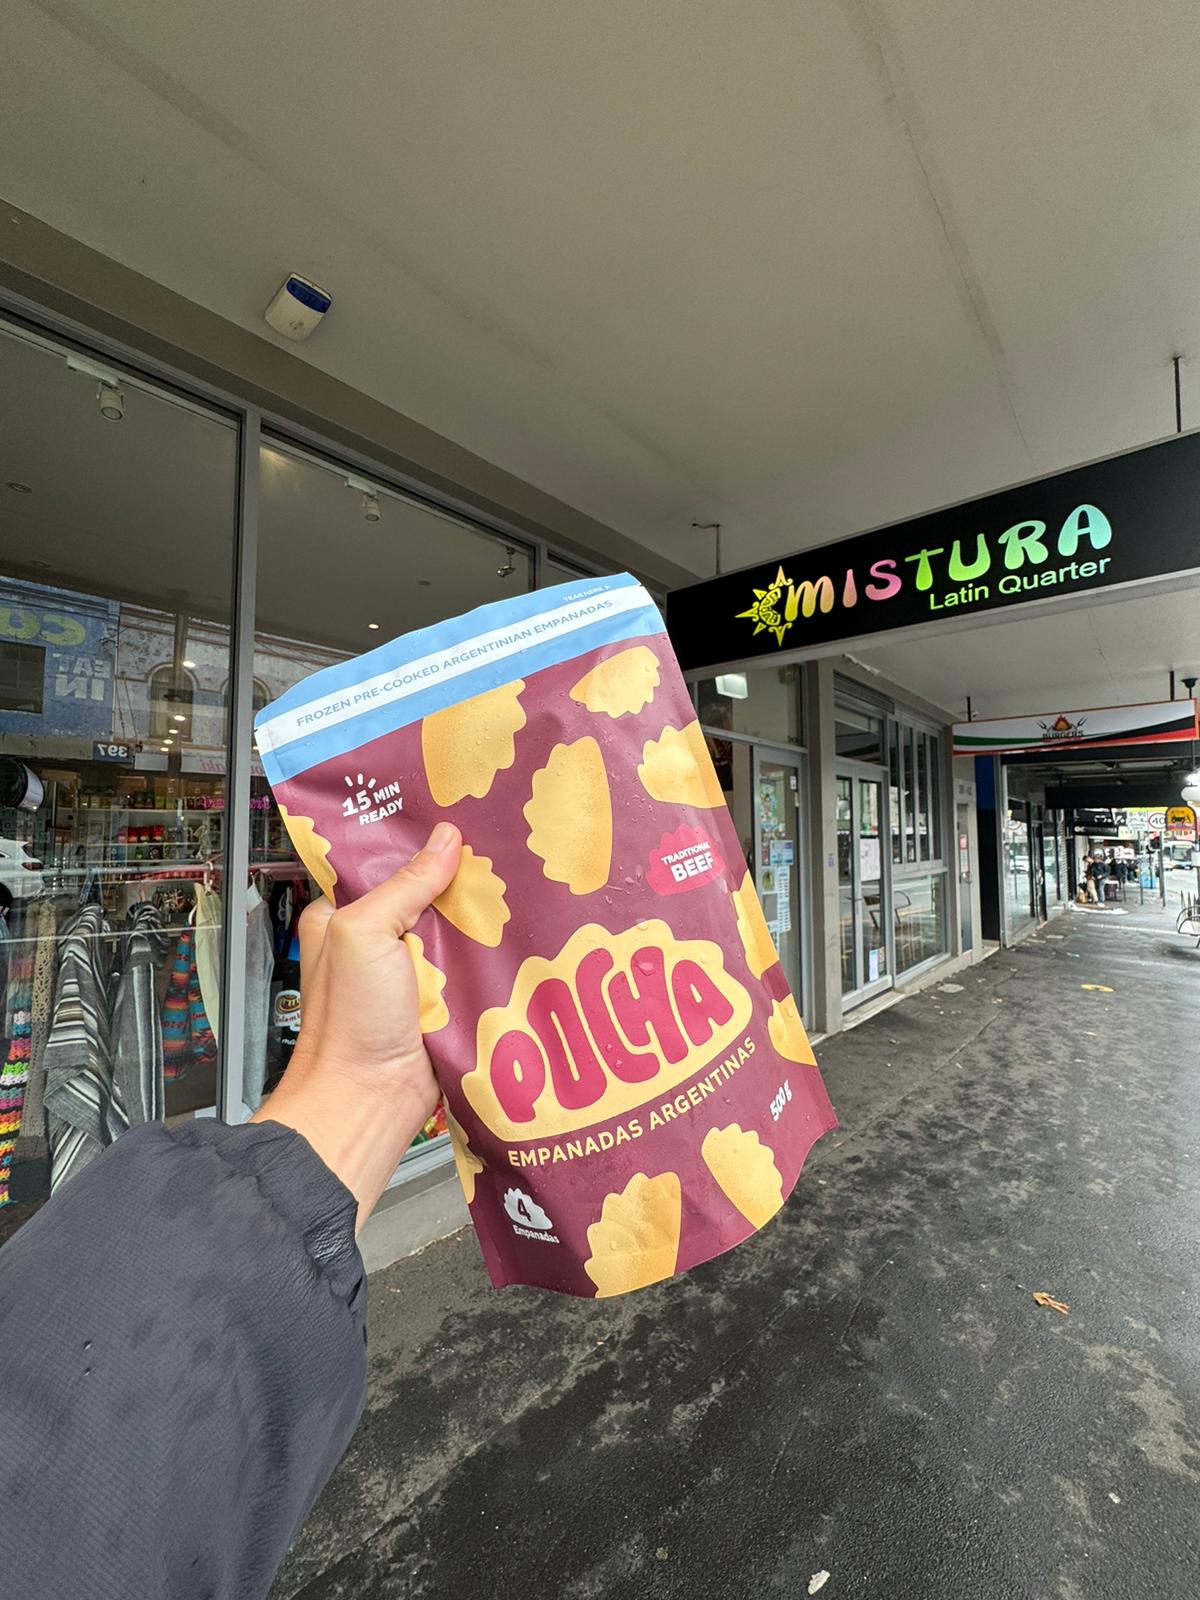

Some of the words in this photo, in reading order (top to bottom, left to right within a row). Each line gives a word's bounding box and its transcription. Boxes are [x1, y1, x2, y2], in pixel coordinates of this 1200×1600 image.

[928, 584, 990, 611] Latin
[998, 555, 1112, 595] Quarter
[296, 698, 352, 727] FROZEN
[353, 664, 441, 705] PRE-COOKED
[442, 628, 533, 670] ARGENTINIAN
[534, 599, 613, 634] EMPANADAS
[342, 790, 372, 817] 15
[373, 781, 401, 804] MIN
[358, 799, 404, 826] READY
[661, 841, 711, 865] TRADITIONAL
[670, 851, 713, 882] BEEF
[508, 1118, 644, 1167] EMPANADAS
[649, 1036, 757, 1131] ARGENTINAS
[769, 1079, 793, 1122] 500g
[517, 1198, 532, 1222] 4
[513, 1225, 560, 1243] Empanadas
